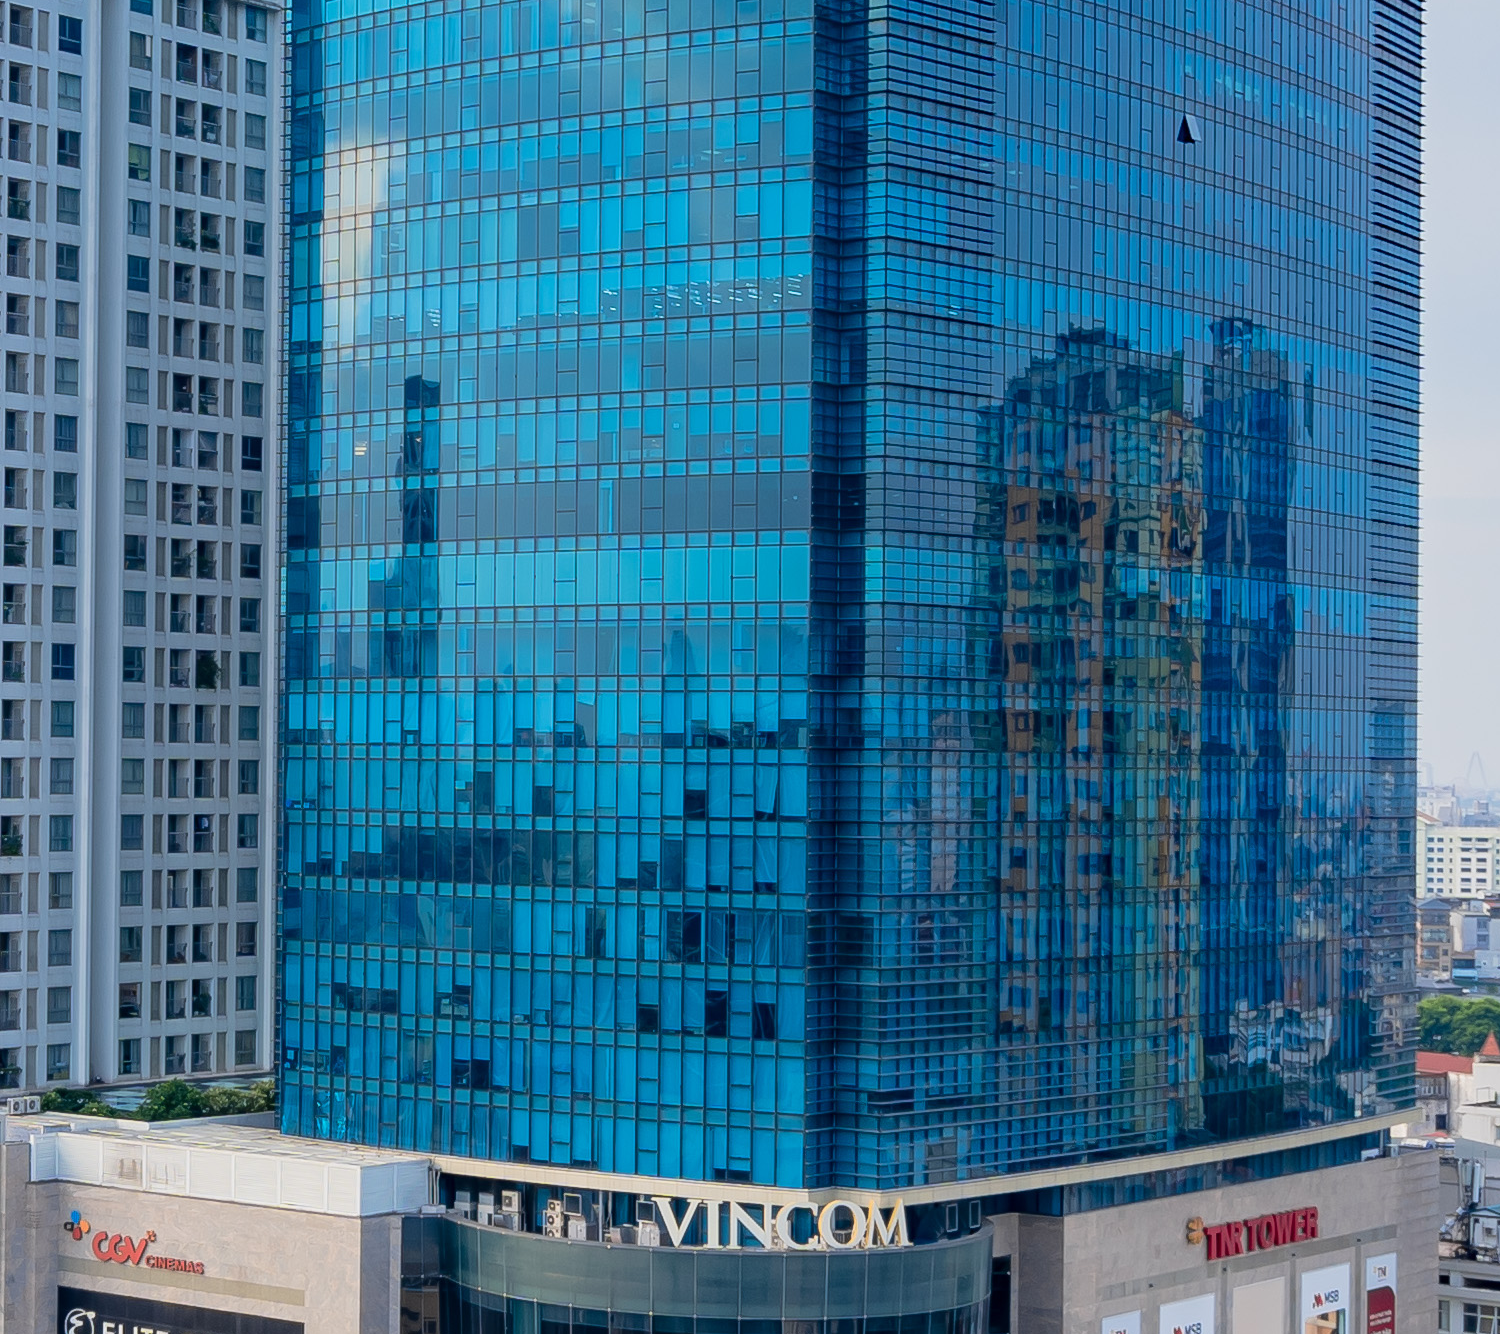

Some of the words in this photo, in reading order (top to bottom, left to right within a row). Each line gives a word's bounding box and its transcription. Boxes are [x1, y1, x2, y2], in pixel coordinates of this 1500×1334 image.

[652, 1197, 914, 1250] VINCOM
[1203, 1222, 1243, 1260] TNR
[1244, 1206, 1318, 1252] TOWER
[92, 1232, 148, 1265] CGV
[145, 1255, 204, 1275] CINEMAS
[1324, 1289, 1339, 1304] MSB
